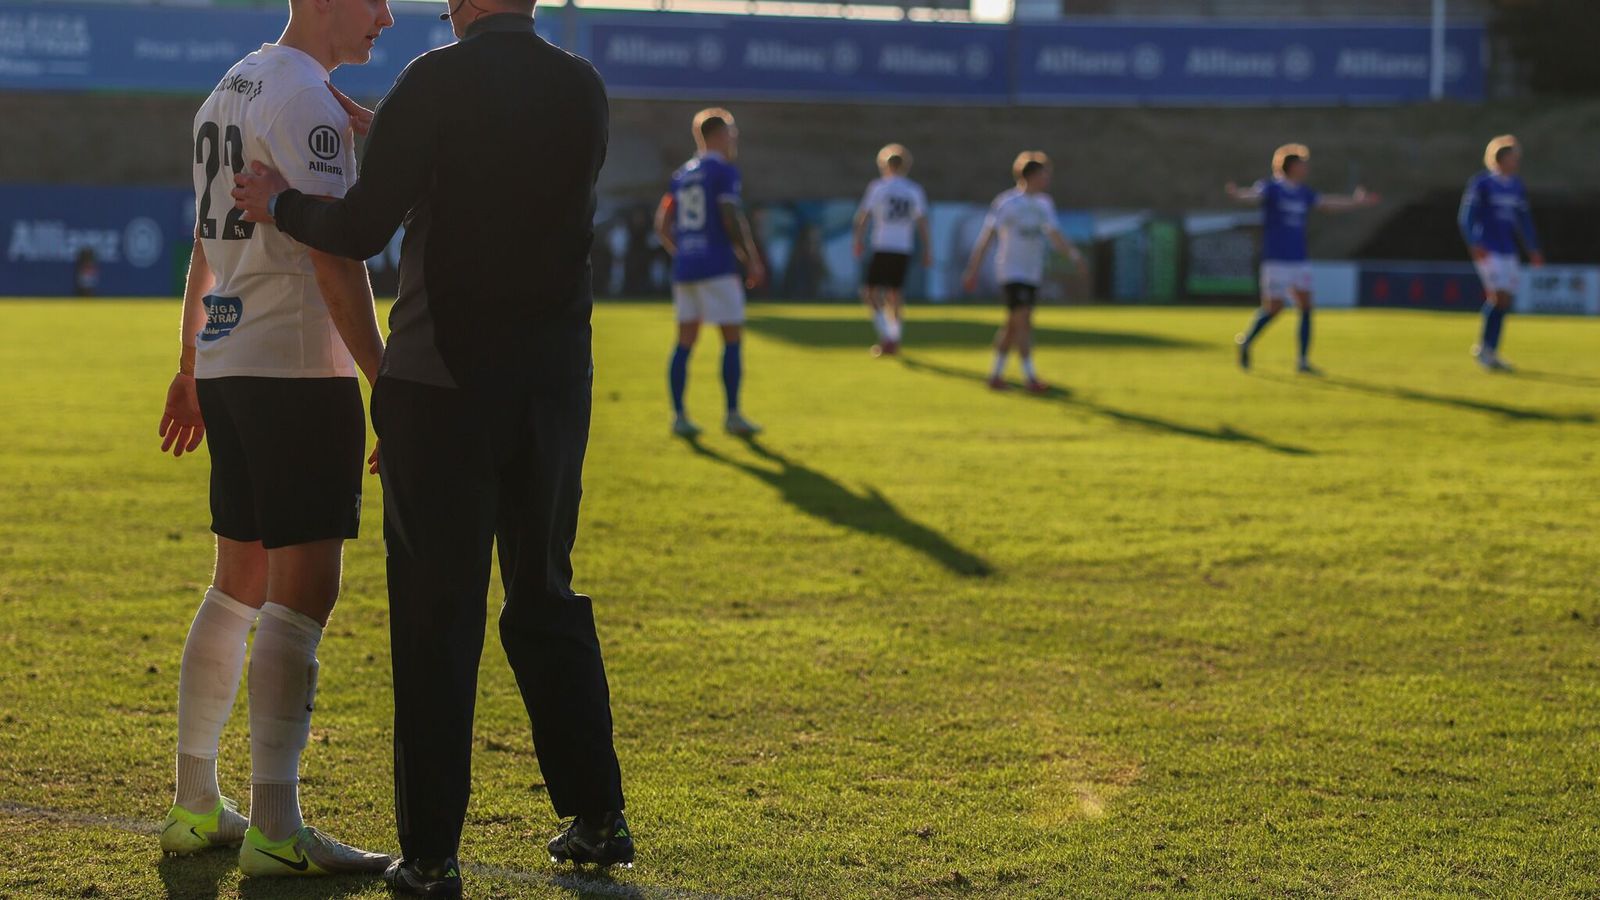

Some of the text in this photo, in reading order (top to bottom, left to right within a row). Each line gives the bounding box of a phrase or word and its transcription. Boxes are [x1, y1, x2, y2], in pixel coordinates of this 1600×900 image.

[196, 121, 256, 240] 22
[309, 161, 343, 176] Allianz
[676, 184, 707, 232] 19
[234, 225, 246, 238] FH
